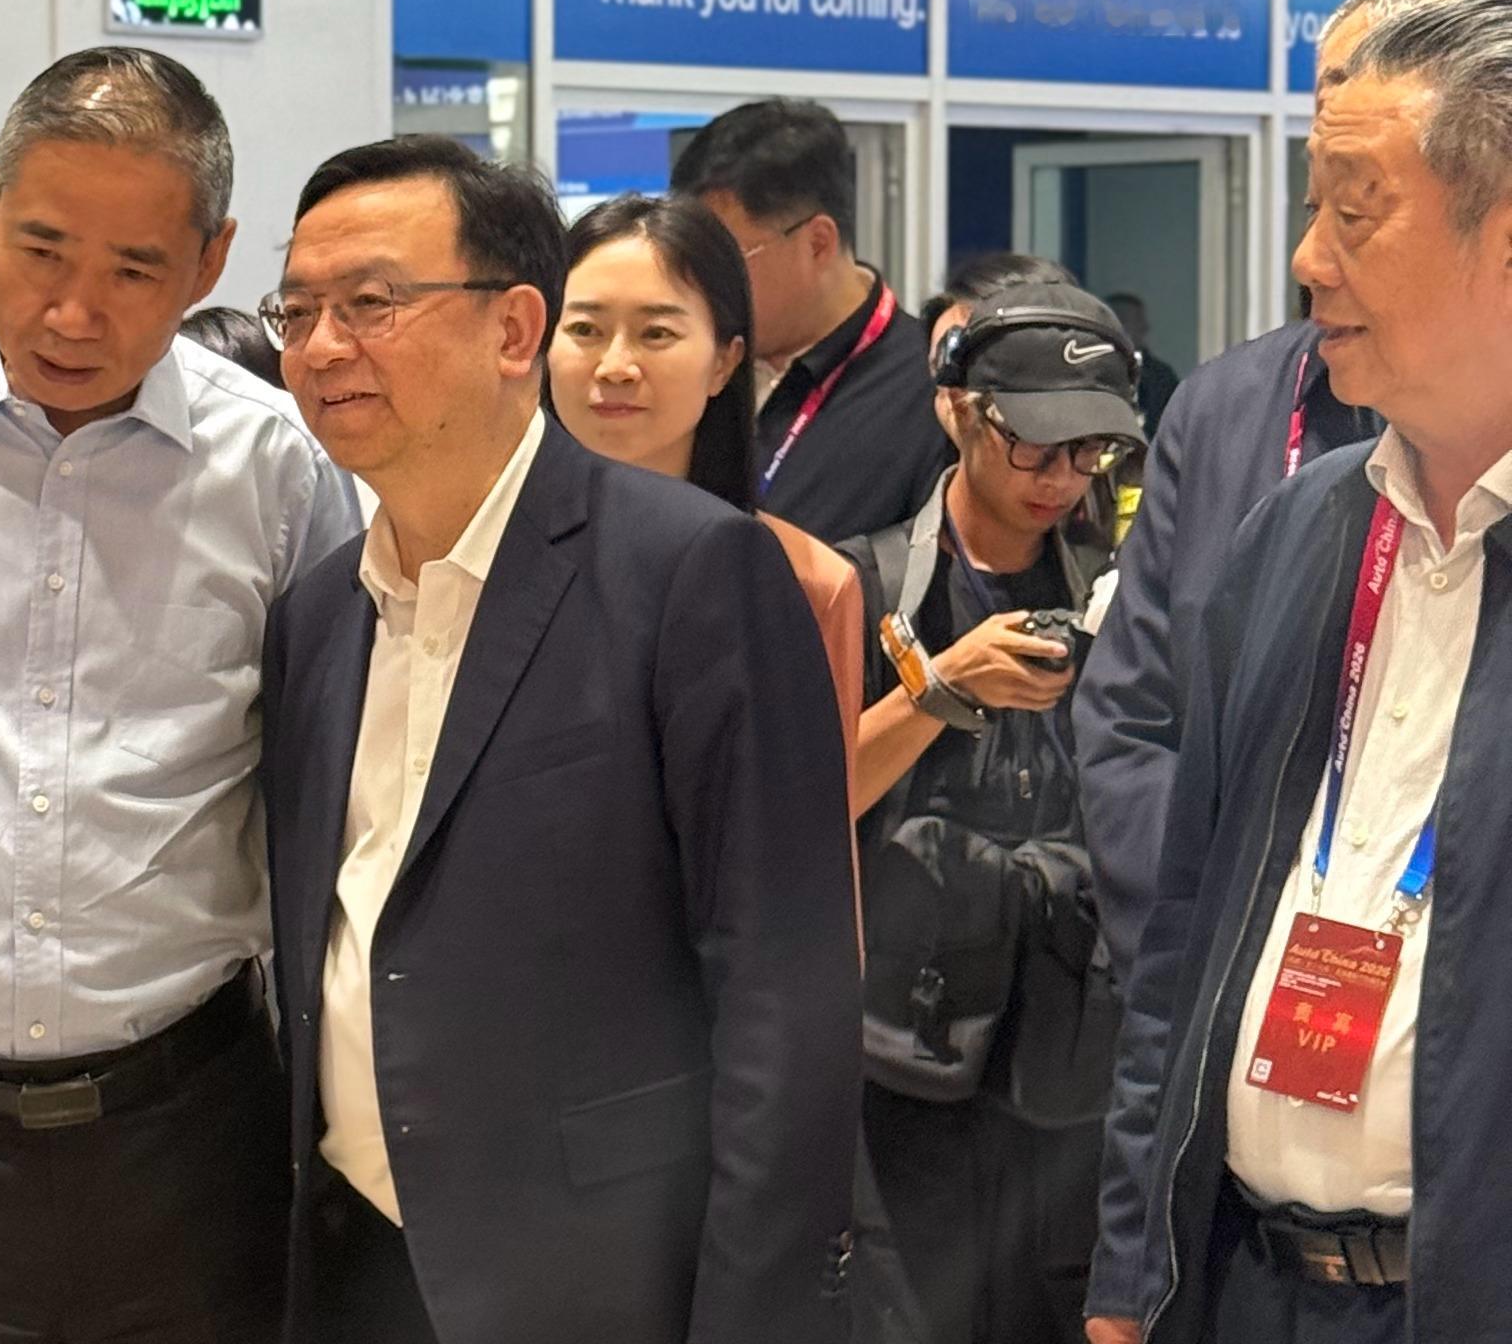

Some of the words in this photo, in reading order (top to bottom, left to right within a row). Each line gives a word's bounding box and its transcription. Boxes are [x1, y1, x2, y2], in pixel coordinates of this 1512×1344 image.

[1374, 512, 1399, 557] Chin
[1367, 556, 1388, 595] Auto
[1299, 1028, 1337, 1053] VIP
